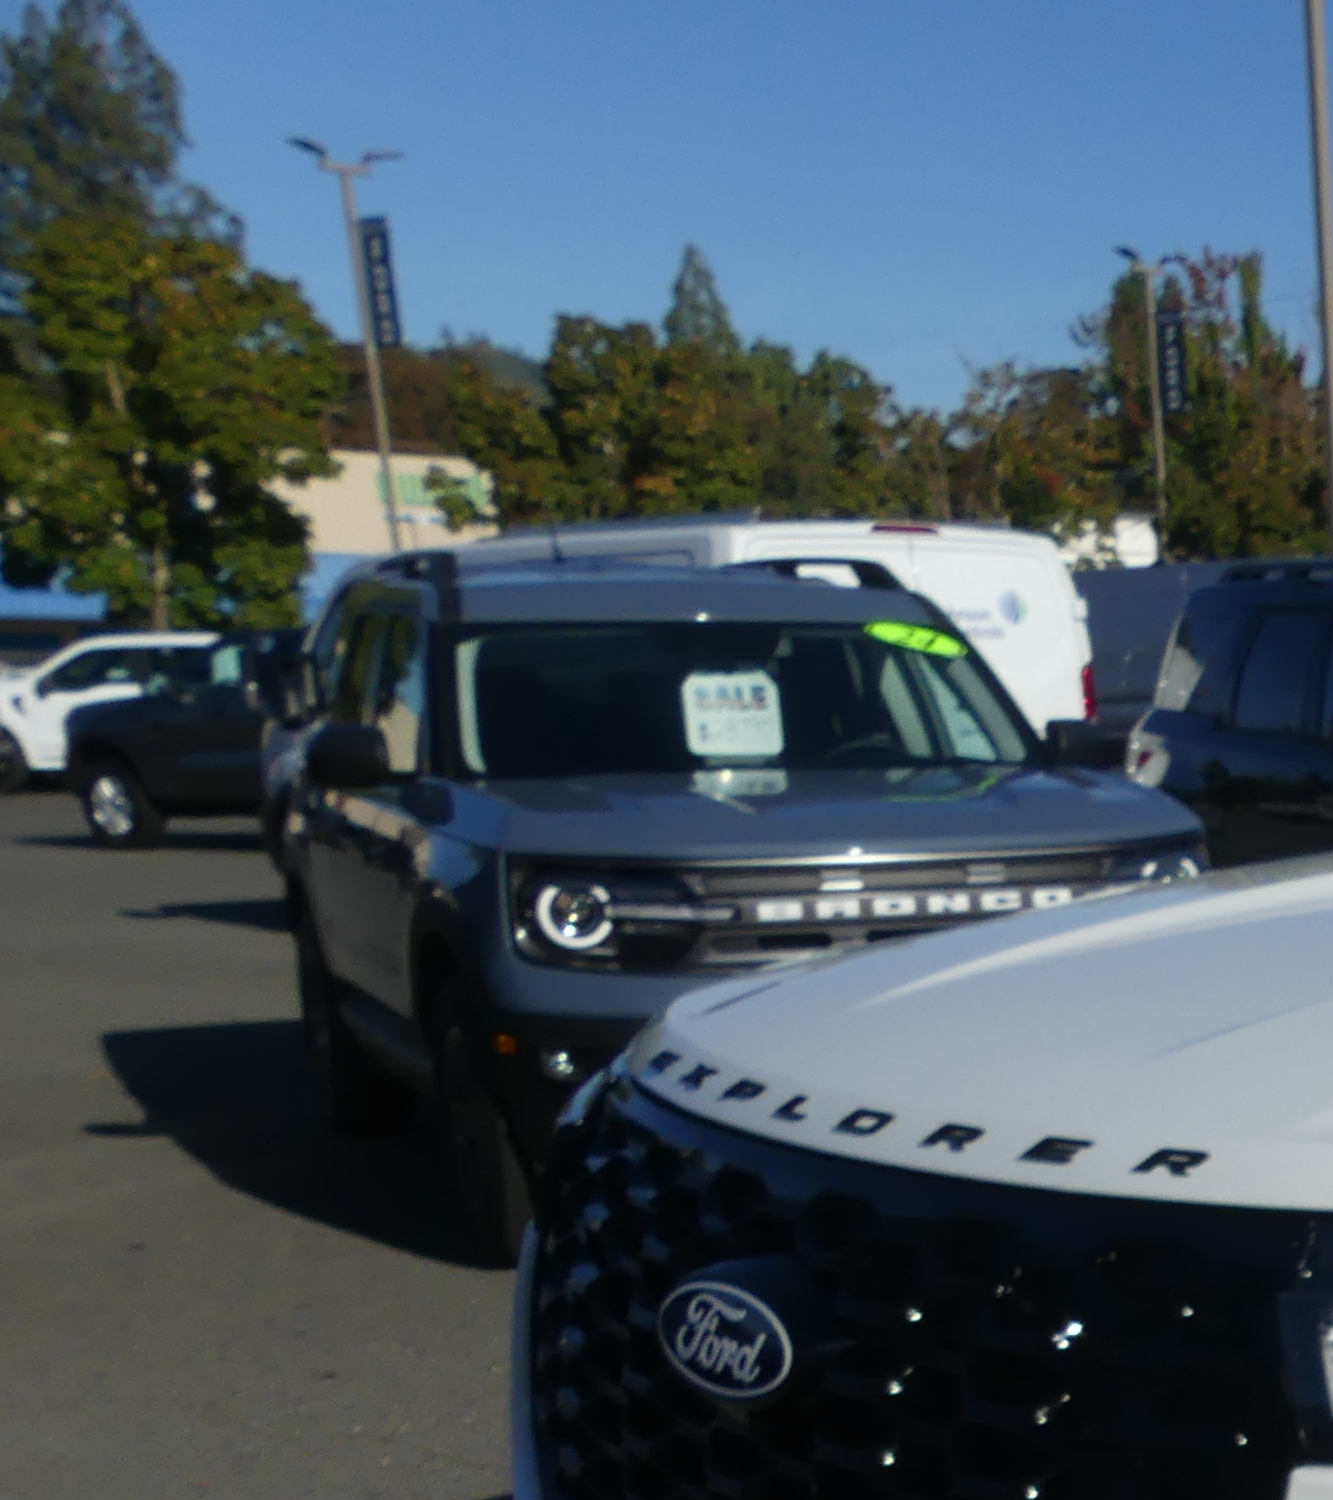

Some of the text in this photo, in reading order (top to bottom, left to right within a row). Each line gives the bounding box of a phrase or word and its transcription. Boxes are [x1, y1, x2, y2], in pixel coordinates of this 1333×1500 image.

[756, 887, 1073, 922] BRONCO
[648, 1050, 1211, 1176] EXPLORER
[675, 1293, 768, 1384] Ford
